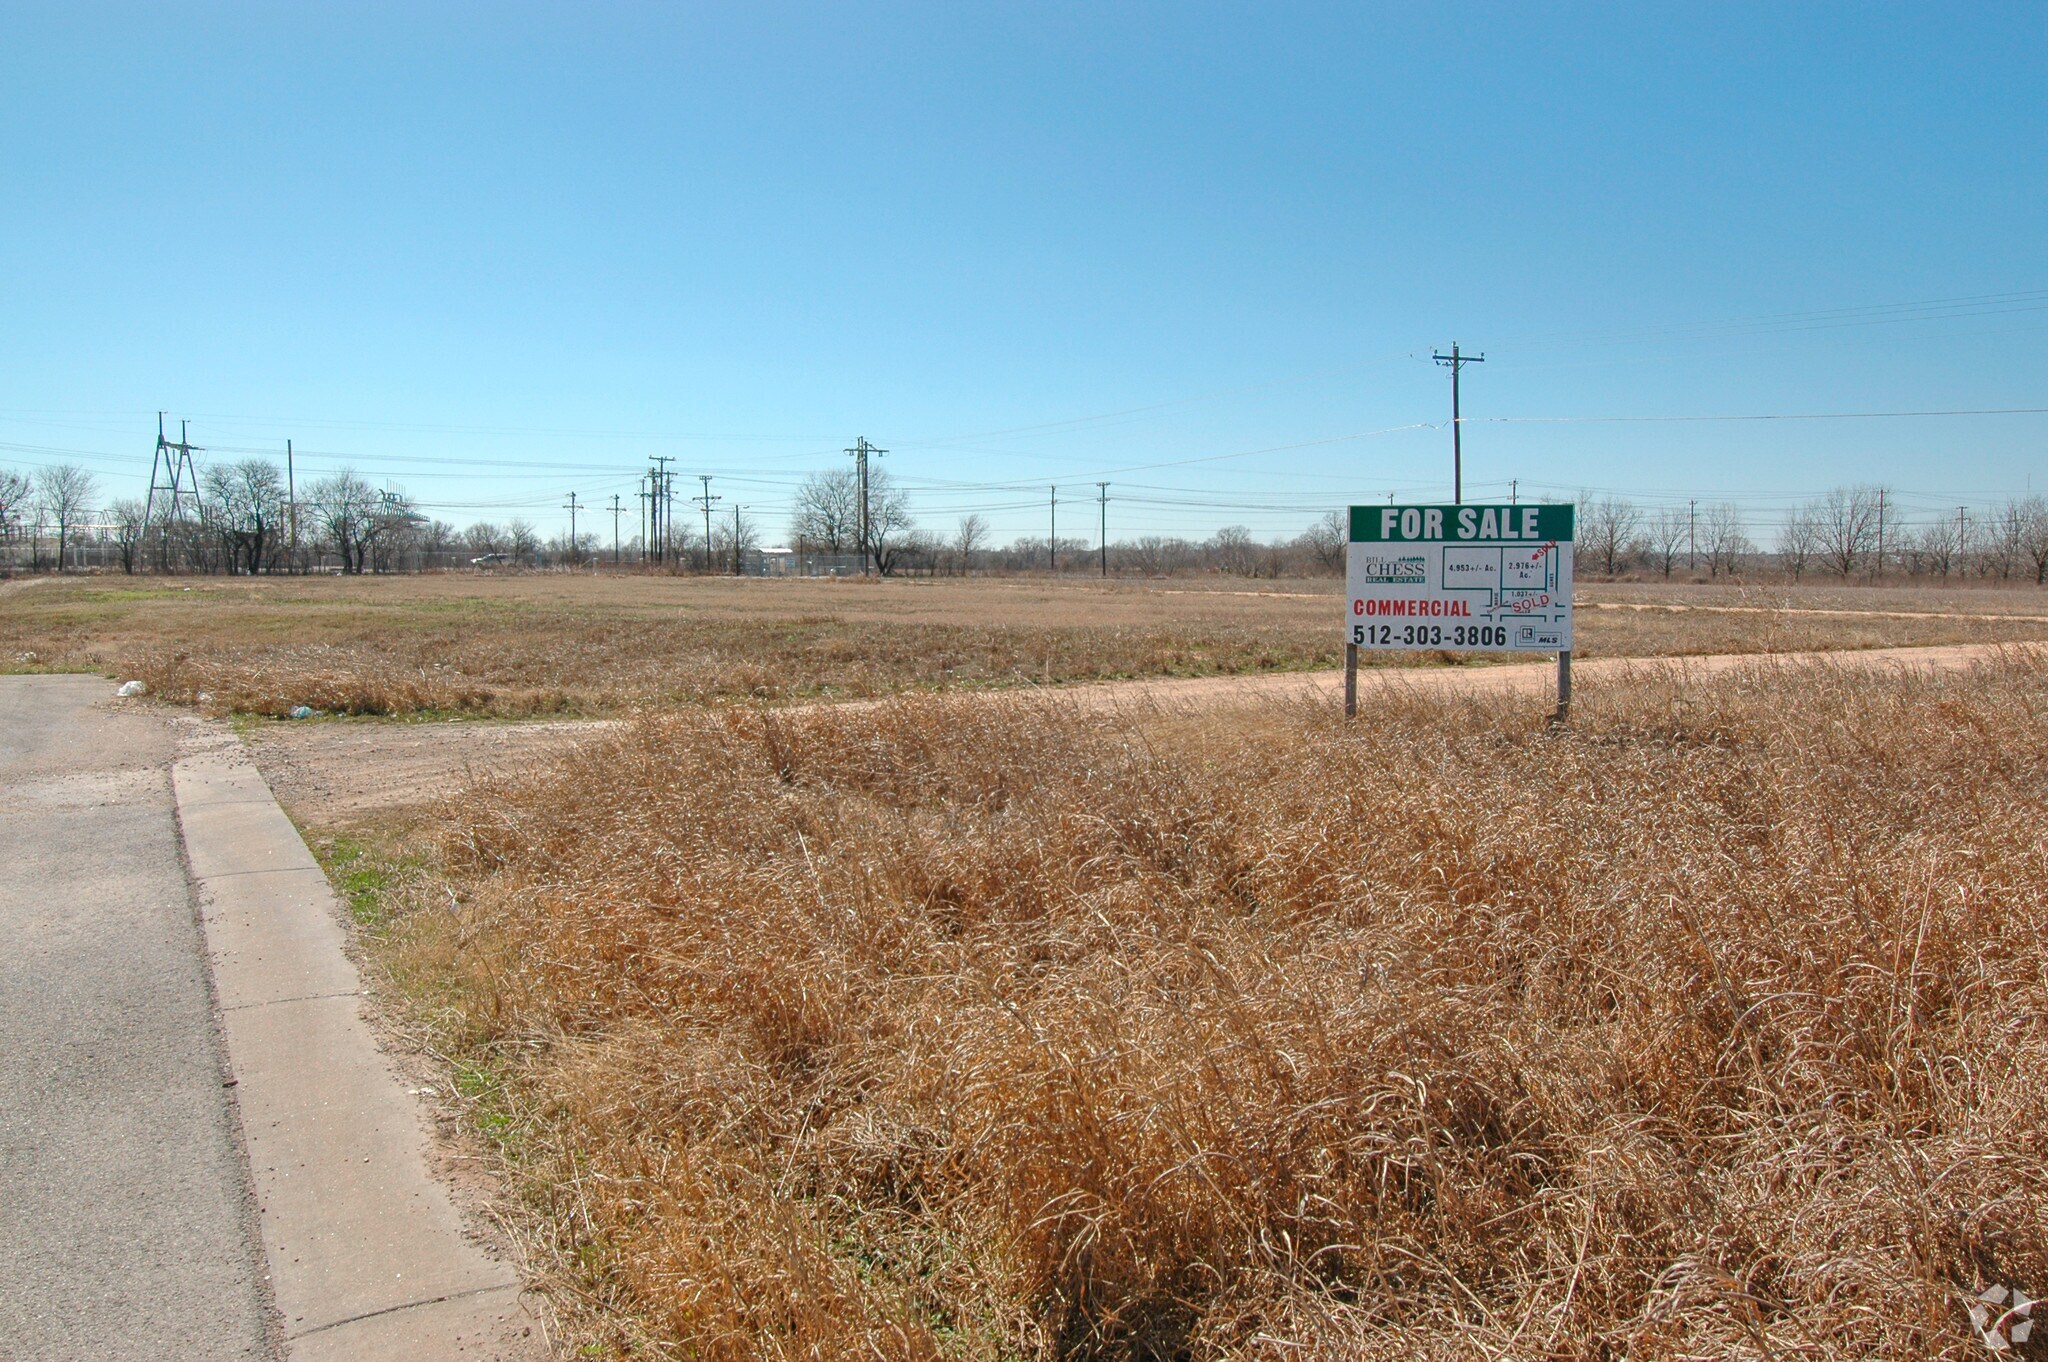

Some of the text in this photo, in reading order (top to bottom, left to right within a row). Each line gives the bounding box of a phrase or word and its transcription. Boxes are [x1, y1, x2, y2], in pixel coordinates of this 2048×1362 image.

[1380, 508, 1539, 539] FOR SALE
[1537, 539, 1557, 557] SOLD
[1366, 563, 1425, 575] CHESS
[1353, 599, 1471, 617] COMMERCIAL
[1512, 594, 1550, 613] SOLD
[1353, 625, 1507, 646] 512-303-3806
